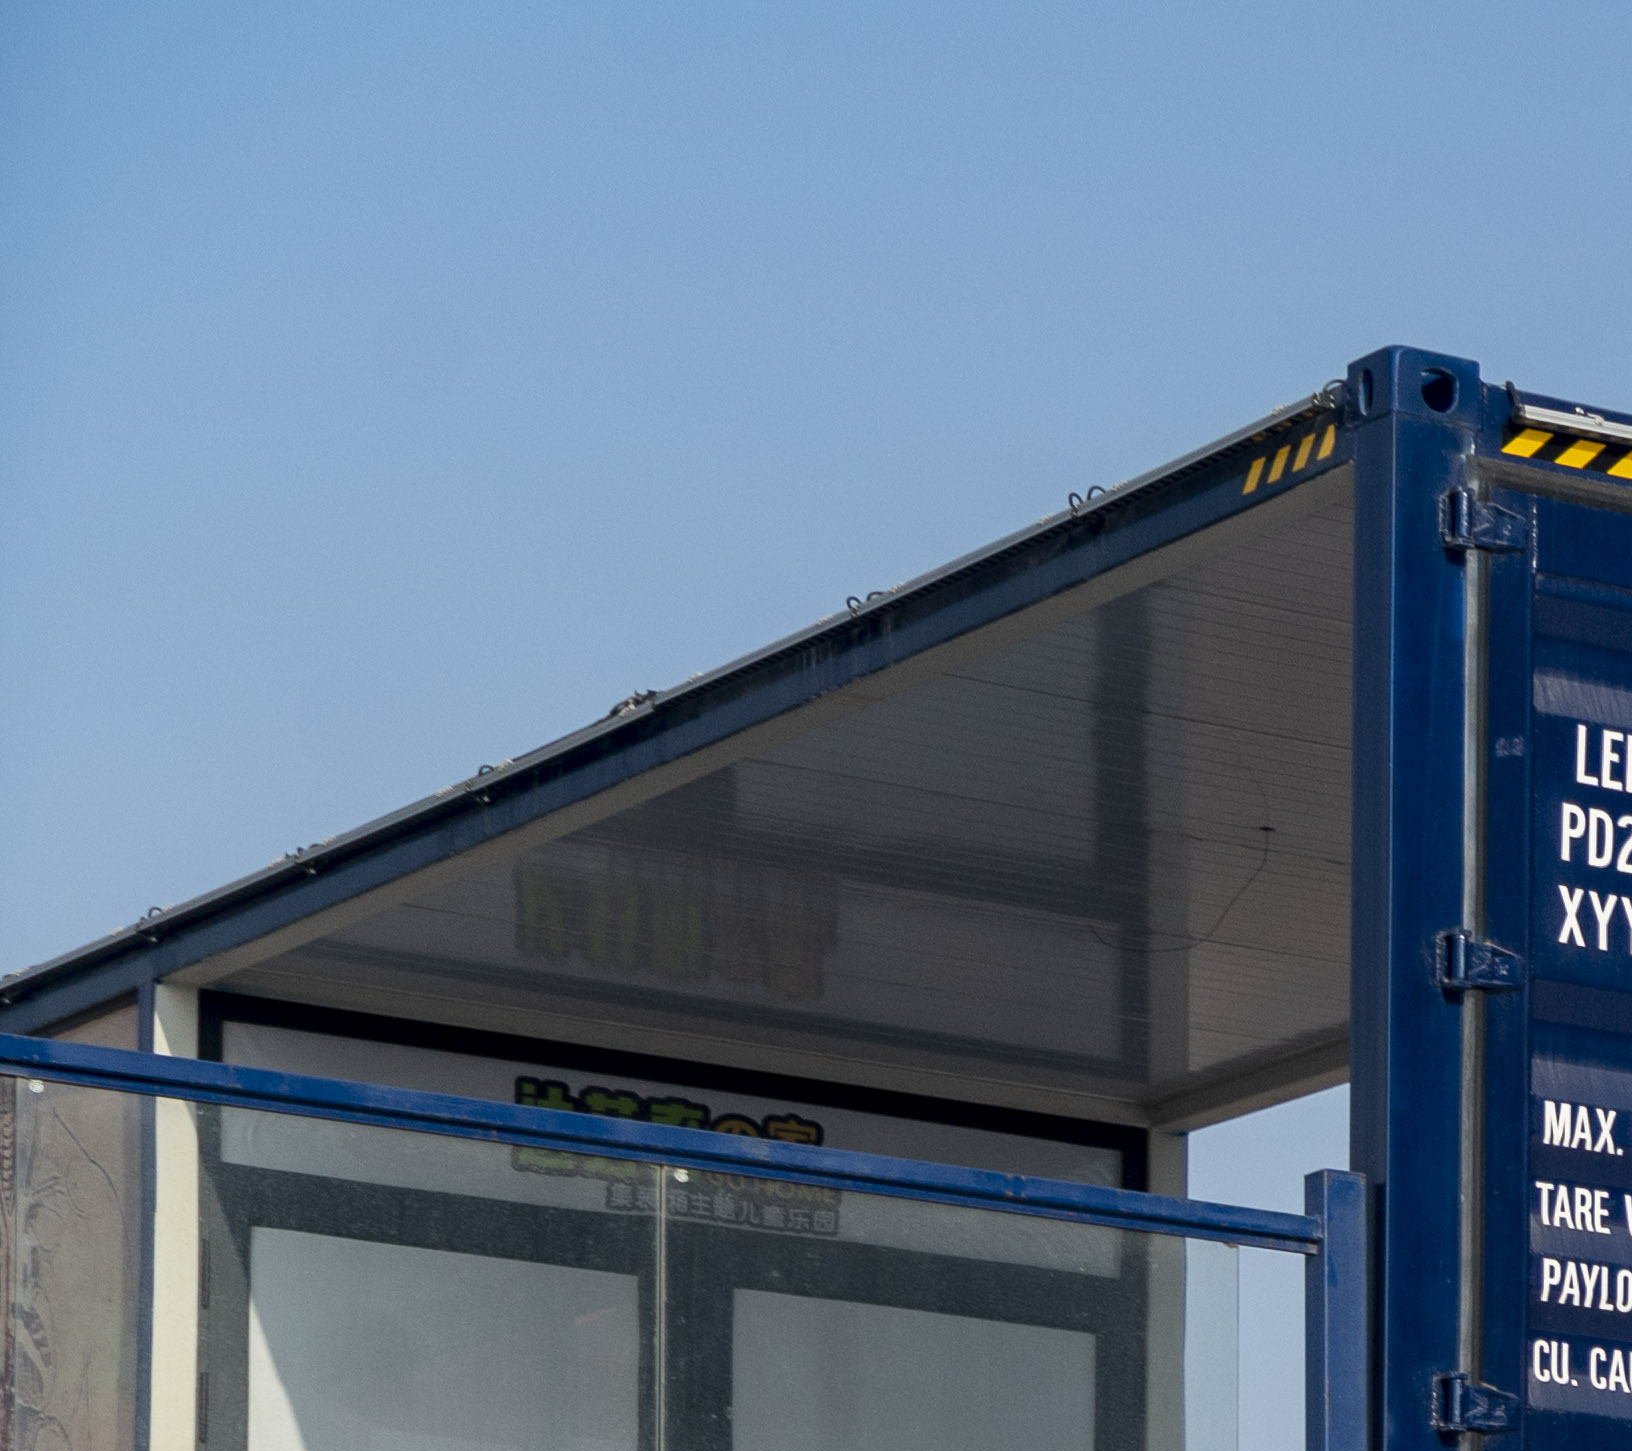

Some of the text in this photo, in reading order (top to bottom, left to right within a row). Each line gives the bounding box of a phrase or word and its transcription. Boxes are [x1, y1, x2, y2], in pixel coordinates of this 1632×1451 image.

[1543, 1101, 1623, 1155] MAX.
[1536, 1182, 1610, 1234] TARE
[1533, 1340, 1578, 1386] CU.
